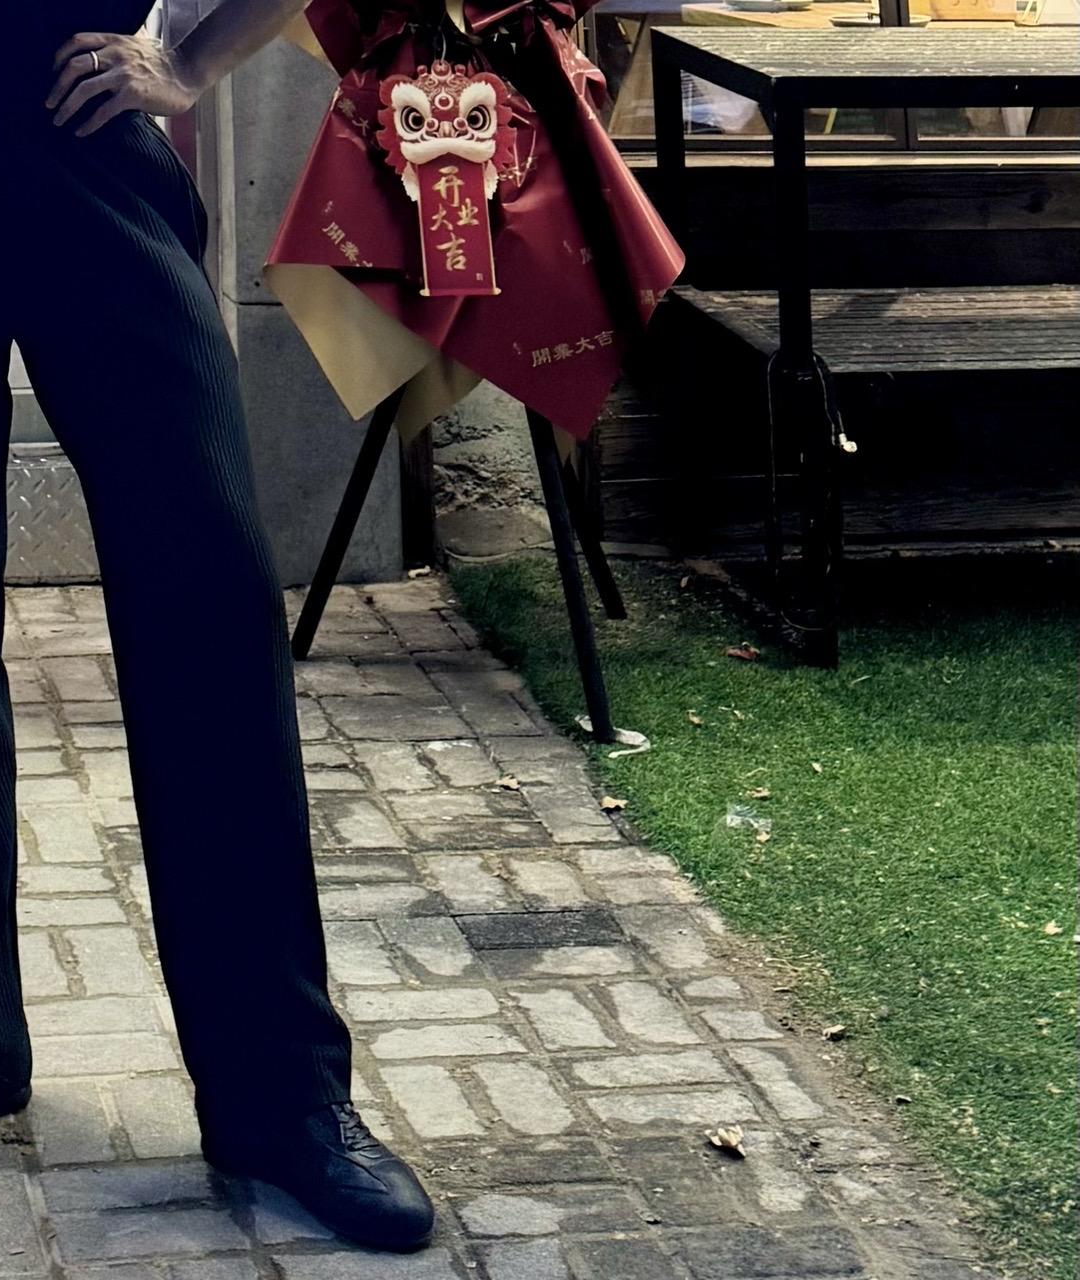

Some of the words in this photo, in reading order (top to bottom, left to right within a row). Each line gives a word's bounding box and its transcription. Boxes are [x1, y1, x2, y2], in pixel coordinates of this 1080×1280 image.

[430, 165, 479, 271] 开业大吉
[531, 329, 616, 367] 開業大吉
